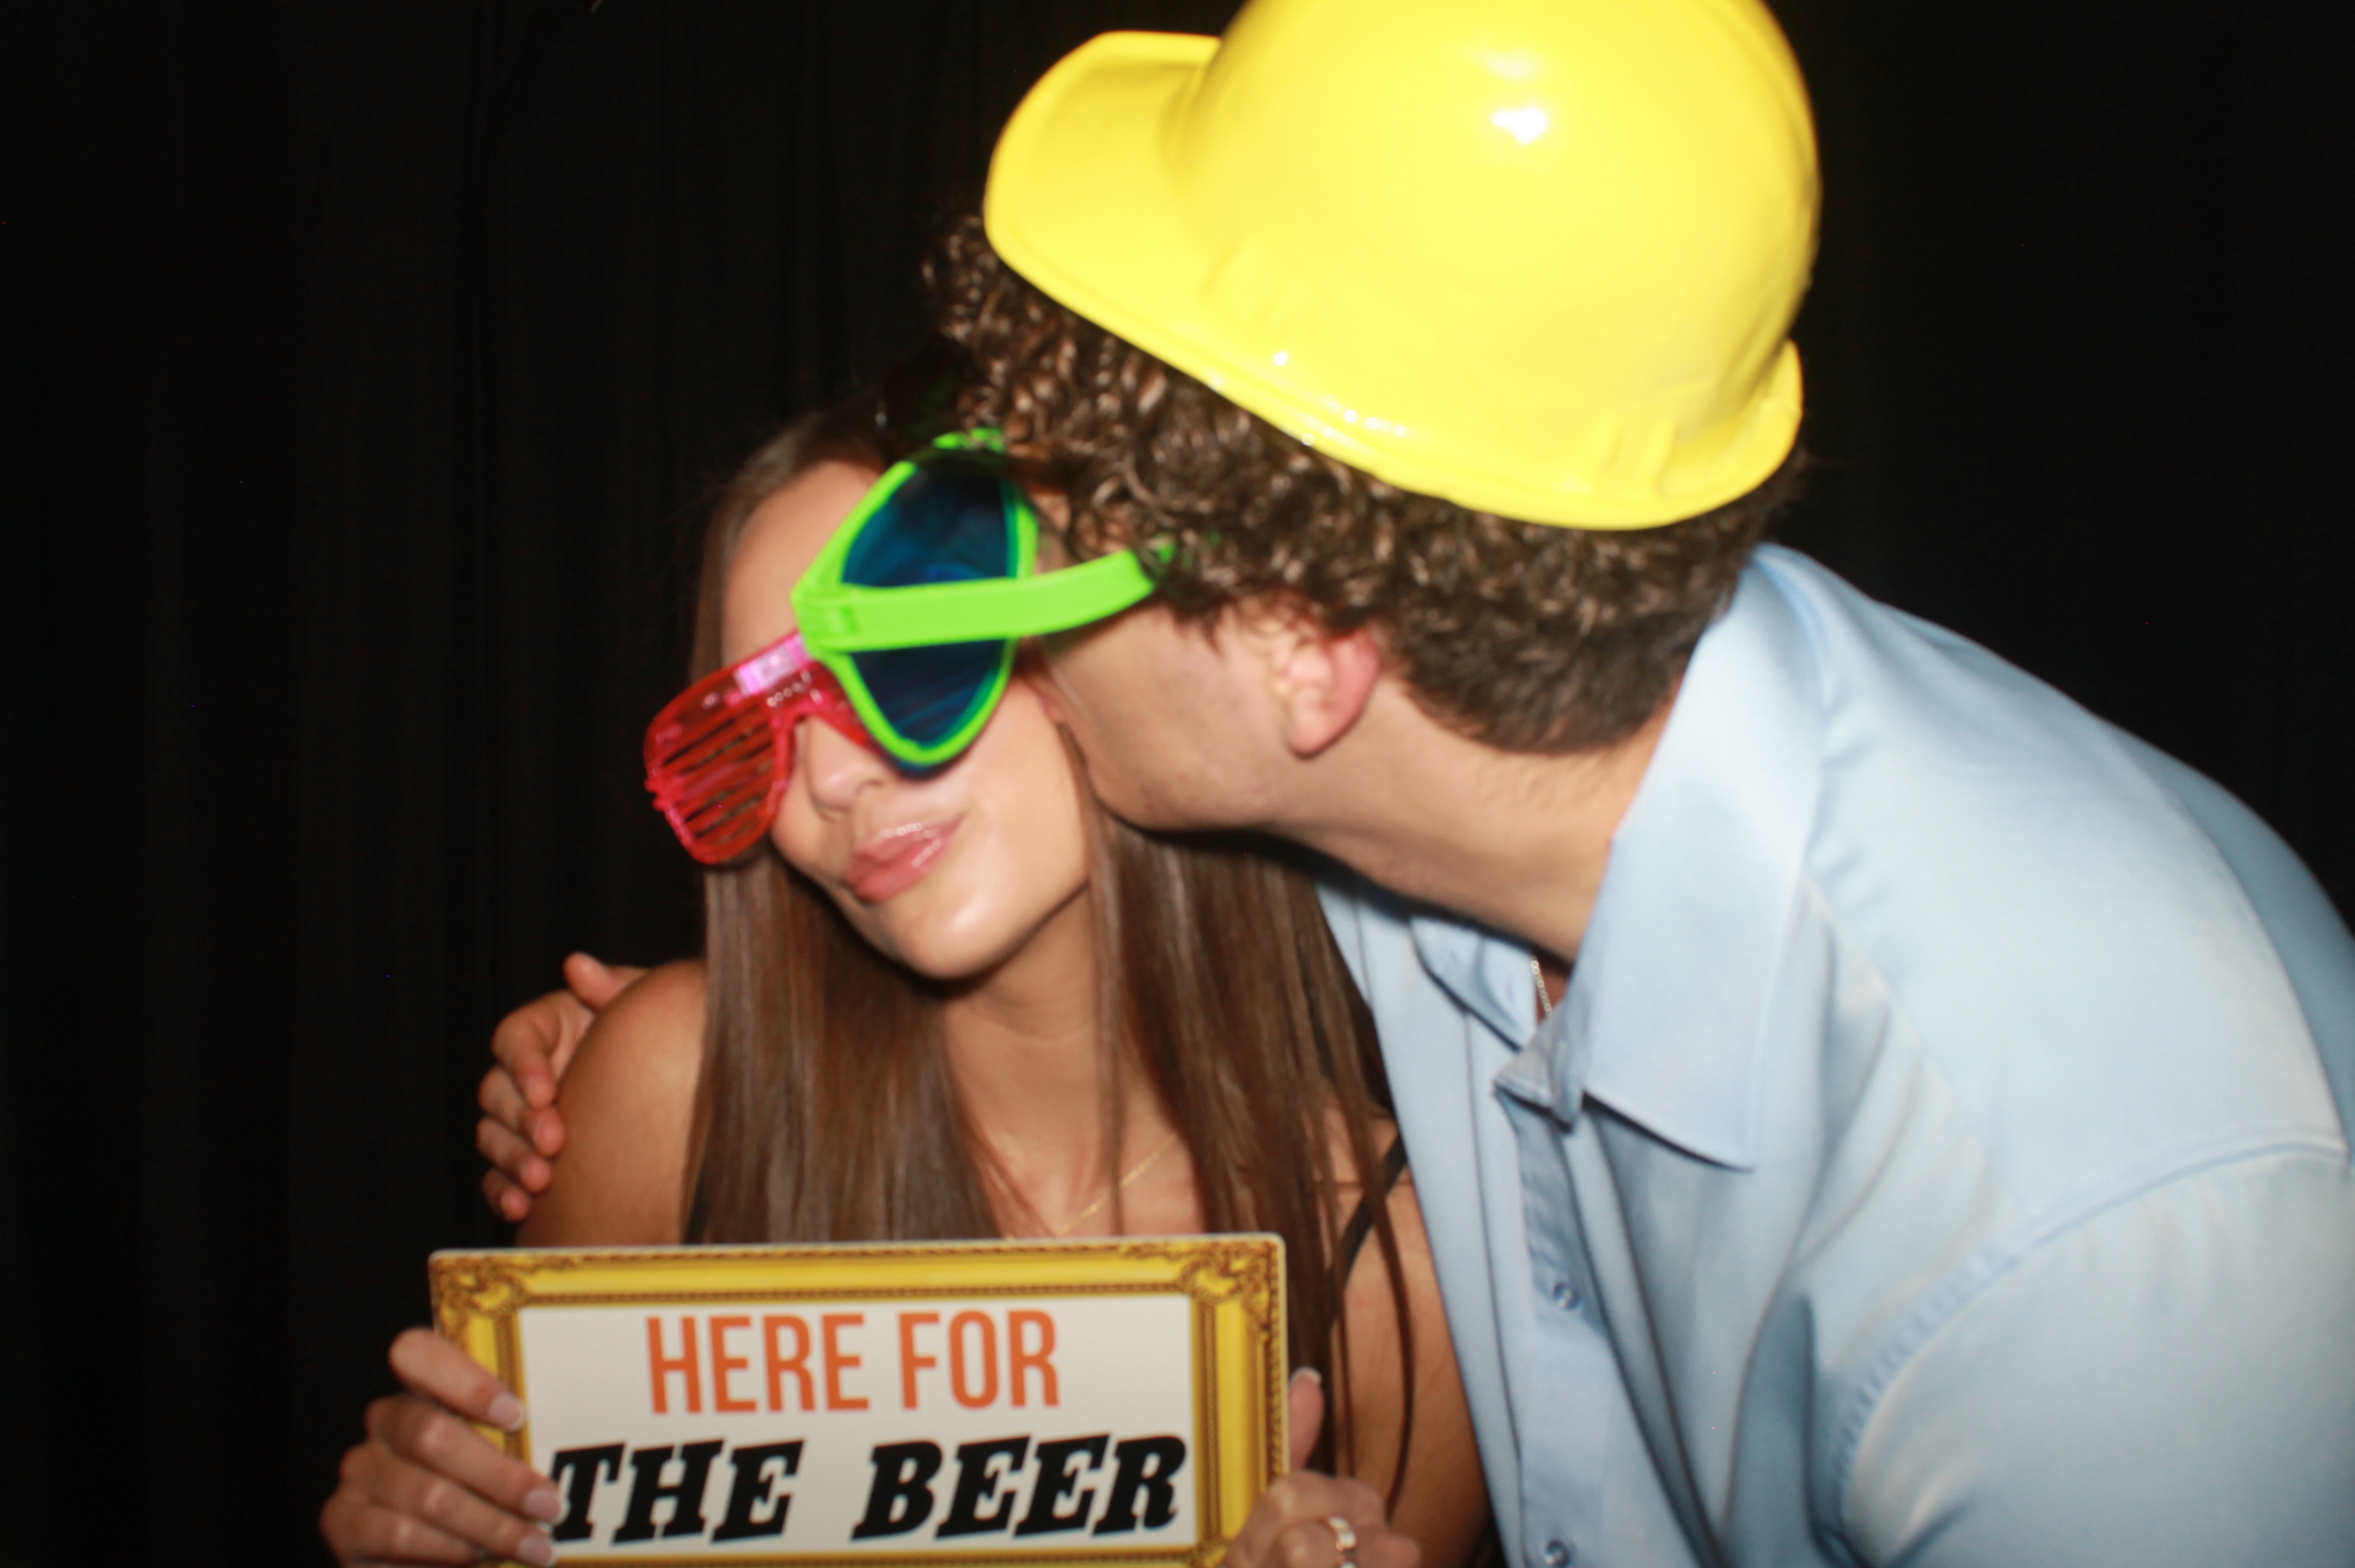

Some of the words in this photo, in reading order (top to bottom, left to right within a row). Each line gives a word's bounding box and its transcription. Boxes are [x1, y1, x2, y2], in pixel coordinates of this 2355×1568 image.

[646, 1312, 869, 1414] HERE
[898, 1309, 1061, 1409] FOR
[549, 1438, 805, 1545] THE
[850, 1432, 1187, 1543] BEER
